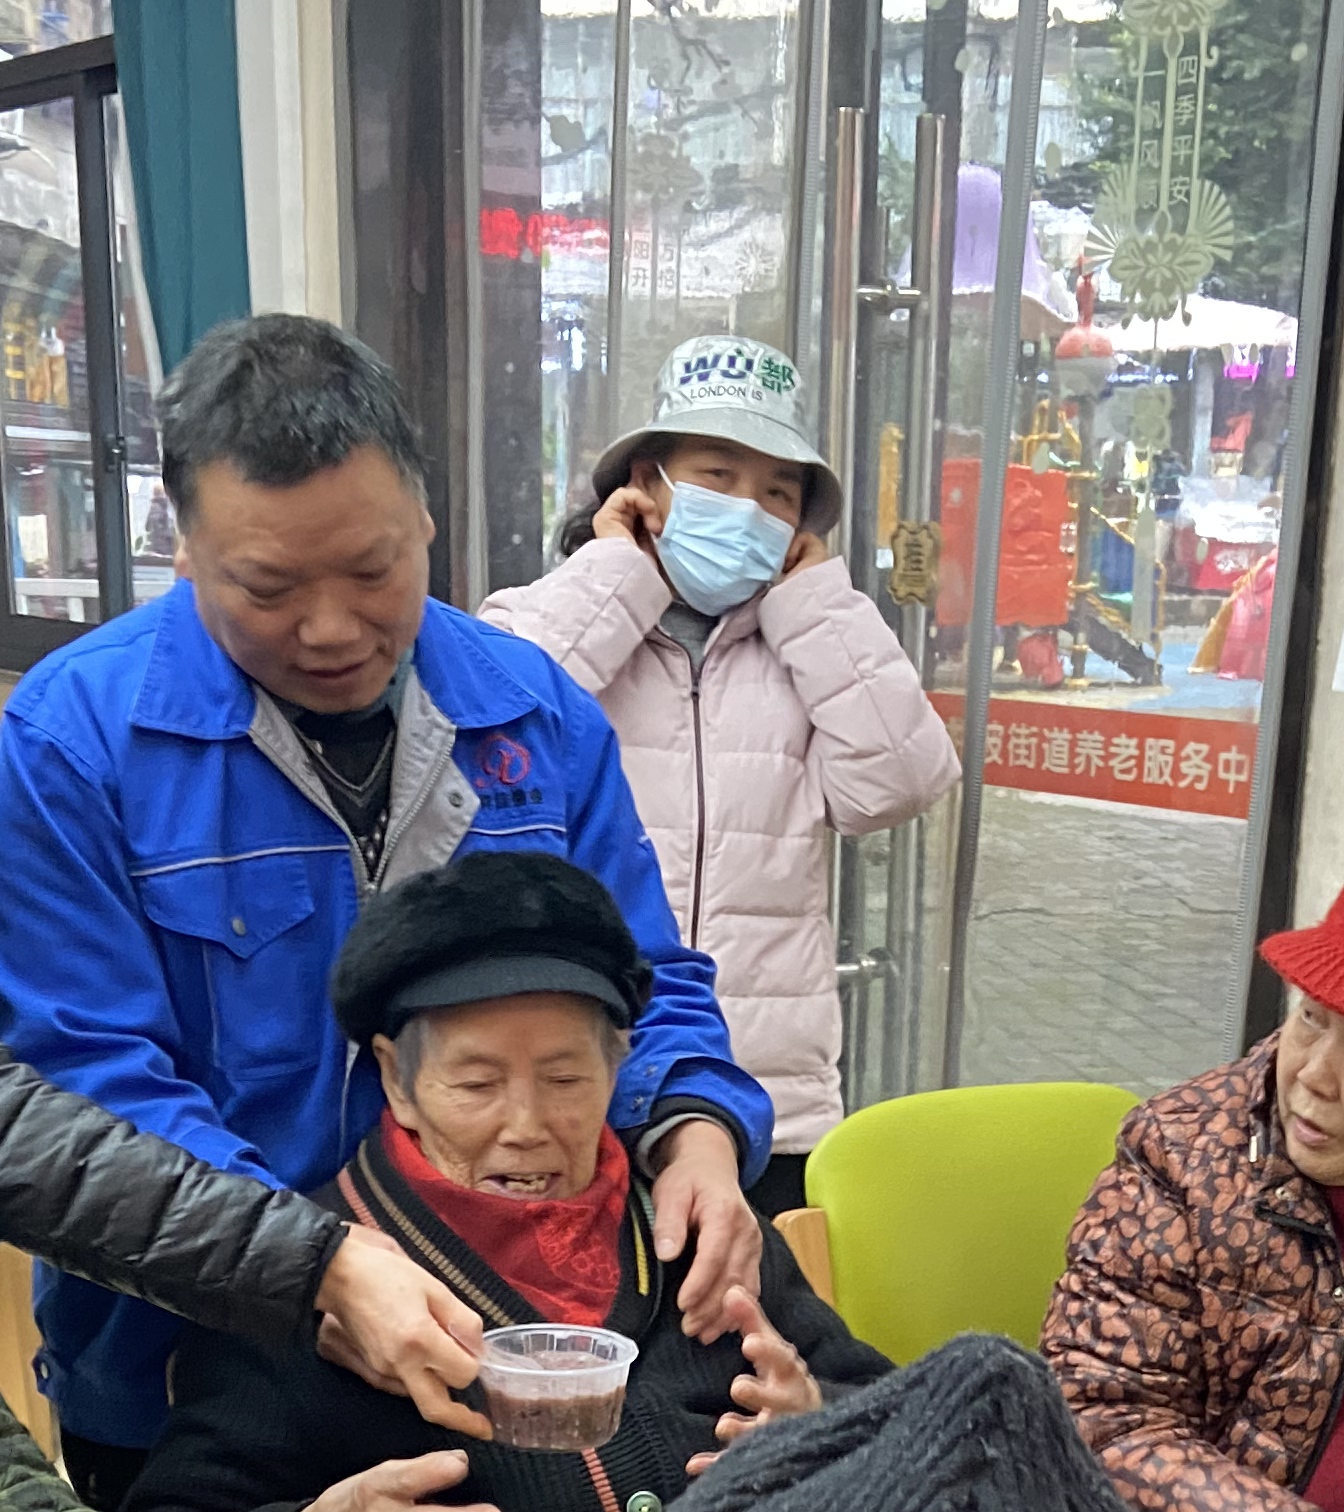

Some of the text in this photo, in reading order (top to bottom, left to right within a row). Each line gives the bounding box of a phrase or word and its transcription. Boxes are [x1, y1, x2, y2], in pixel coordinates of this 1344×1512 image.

[1167, 55, 1198, 206] 四季平安
[690, 384, 747, 400] LONDON
